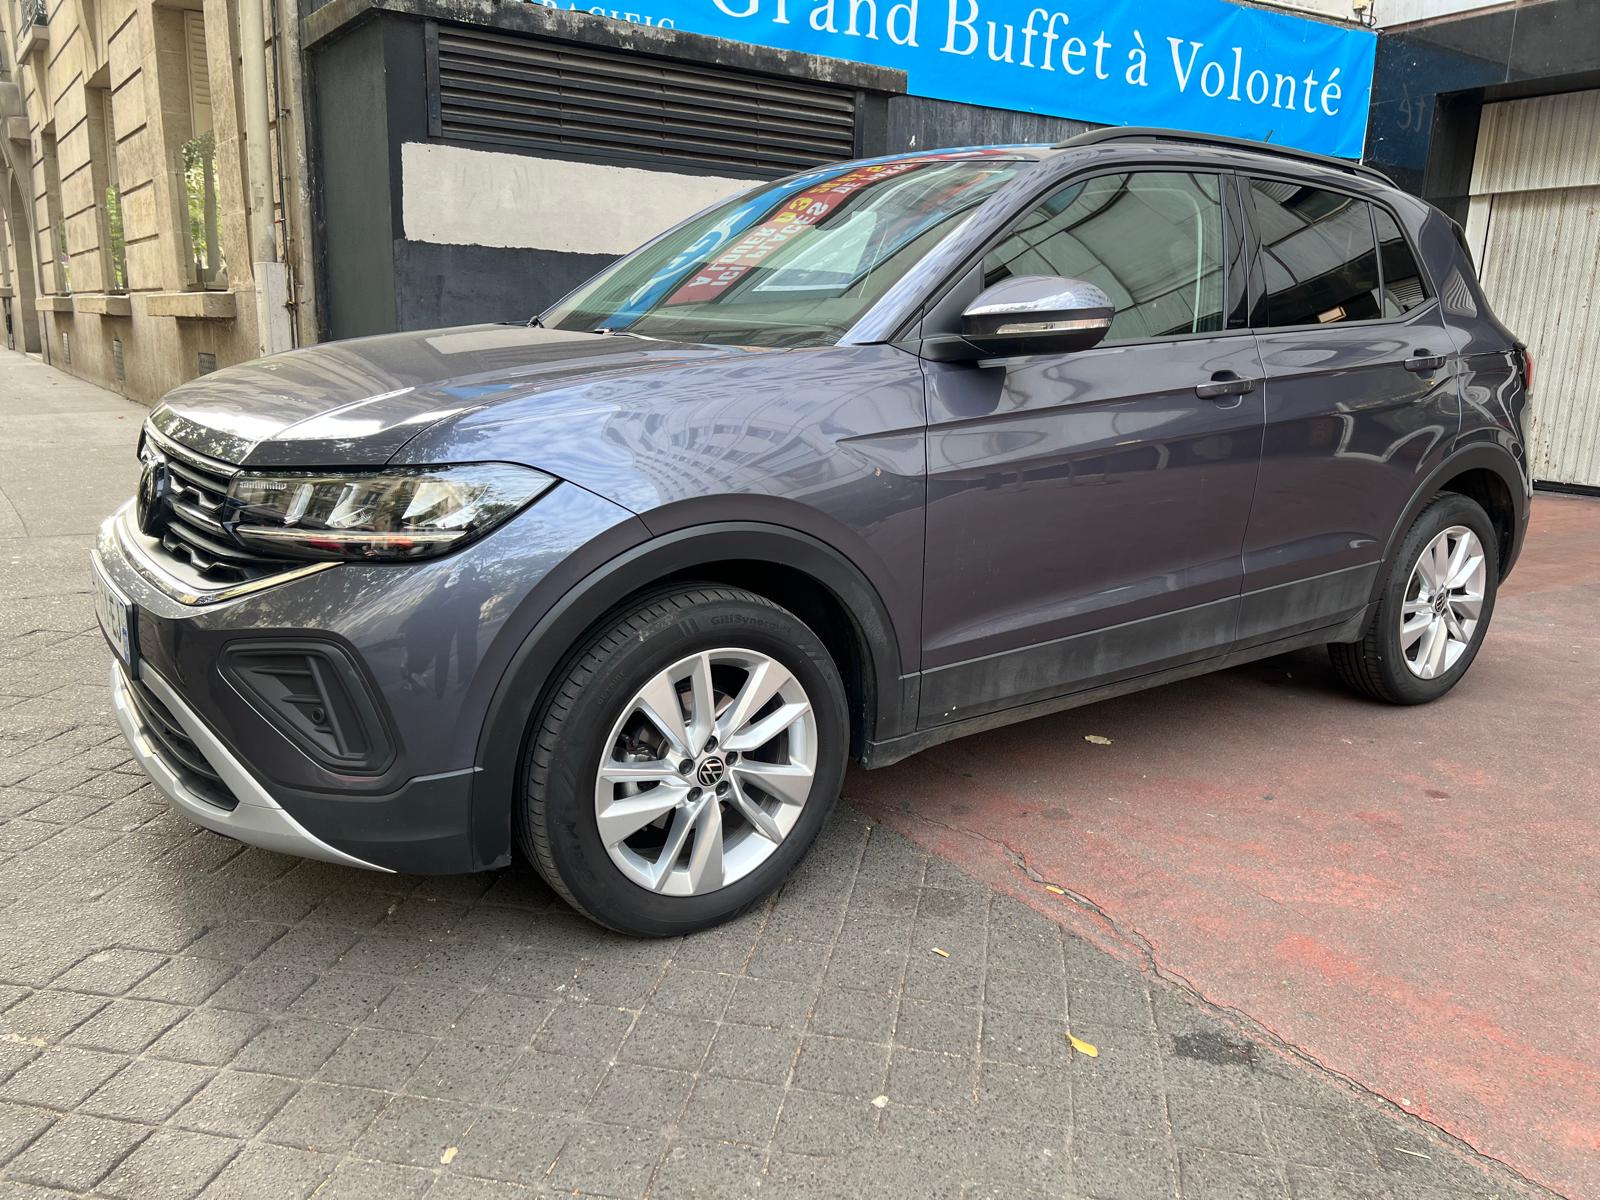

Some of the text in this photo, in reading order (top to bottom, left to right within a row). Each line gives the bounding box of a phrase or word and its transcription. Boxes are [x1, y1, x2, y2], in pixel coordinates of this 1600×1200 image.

[939, 0, 1112, 81] Buffet
[1125, 31, 1148, 87] à
[1166, 36, 1342, 117] Volonté
